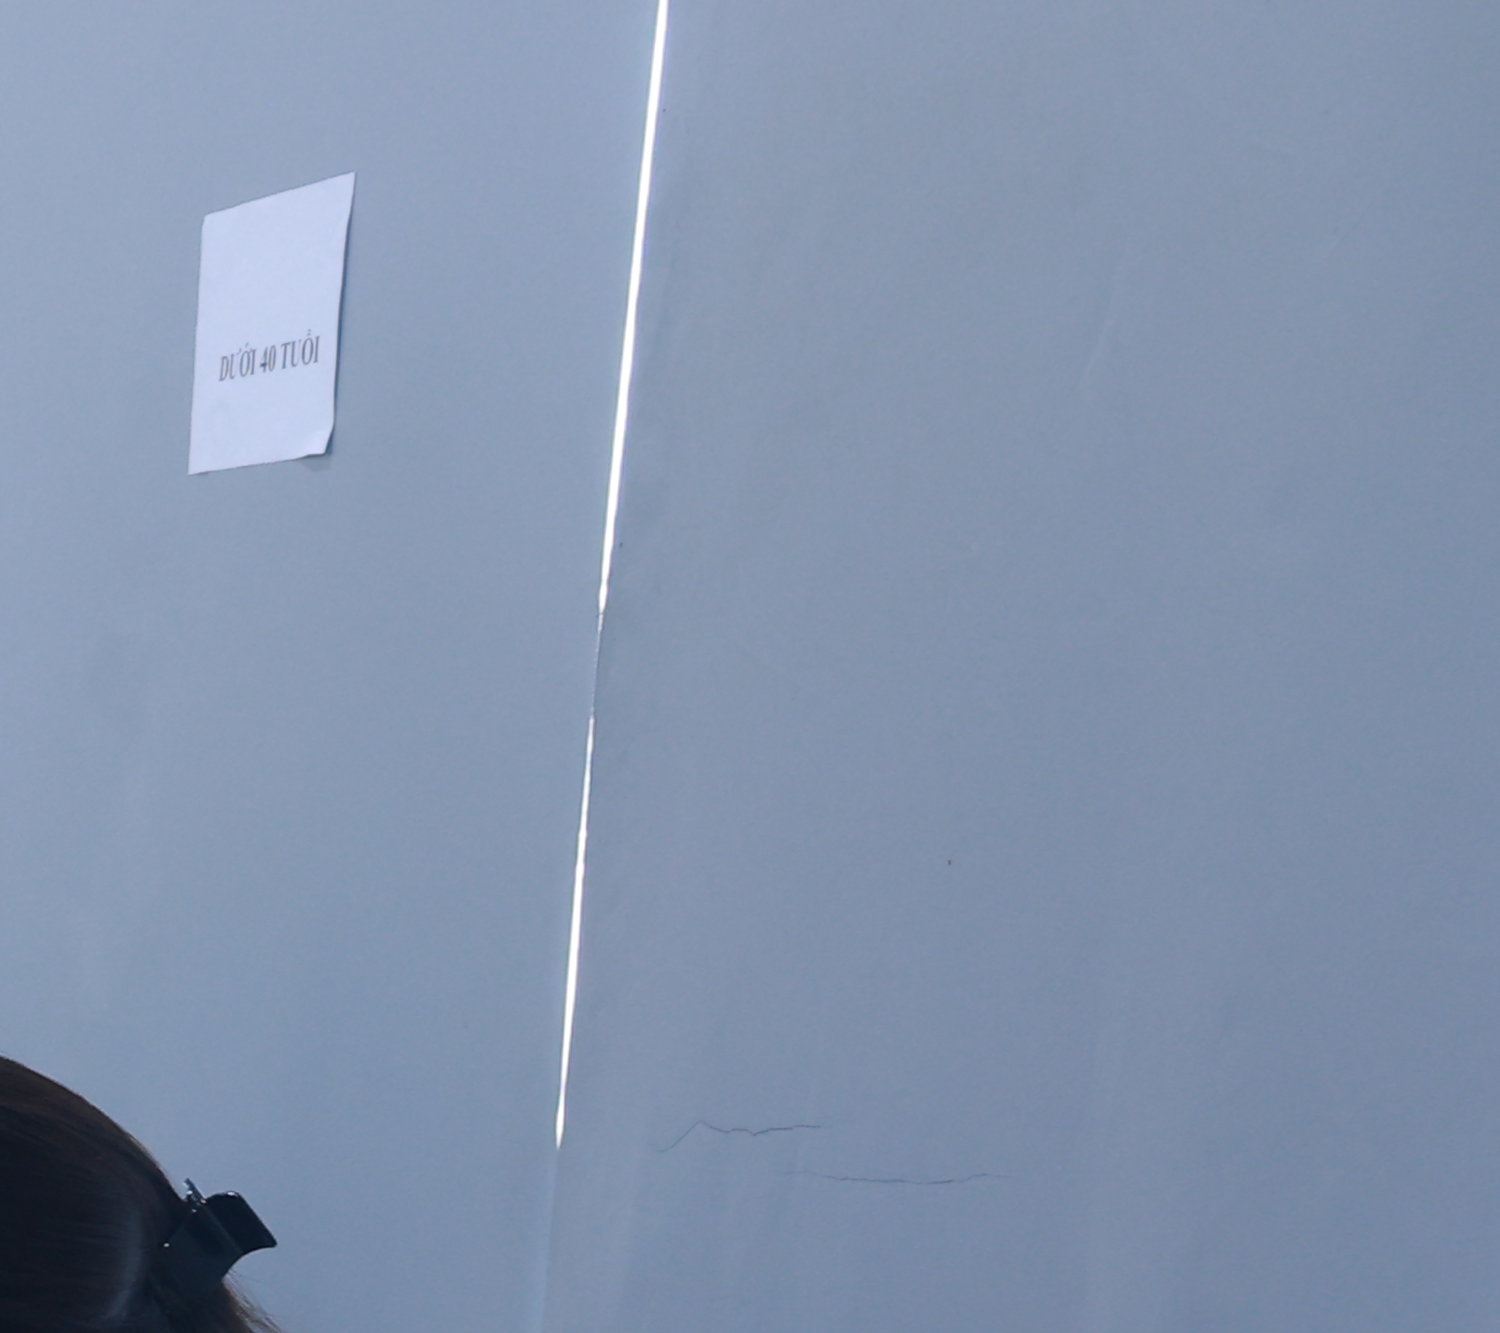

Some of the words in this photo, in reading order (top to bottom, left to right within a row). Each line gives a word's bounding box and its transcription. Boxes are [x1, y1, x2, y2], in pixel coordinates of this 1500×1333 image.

[219, 343, 256, 381] DƯỚI
[259, 346, 276, 373] 40
[281, 328, 321, 370] TUỔI
